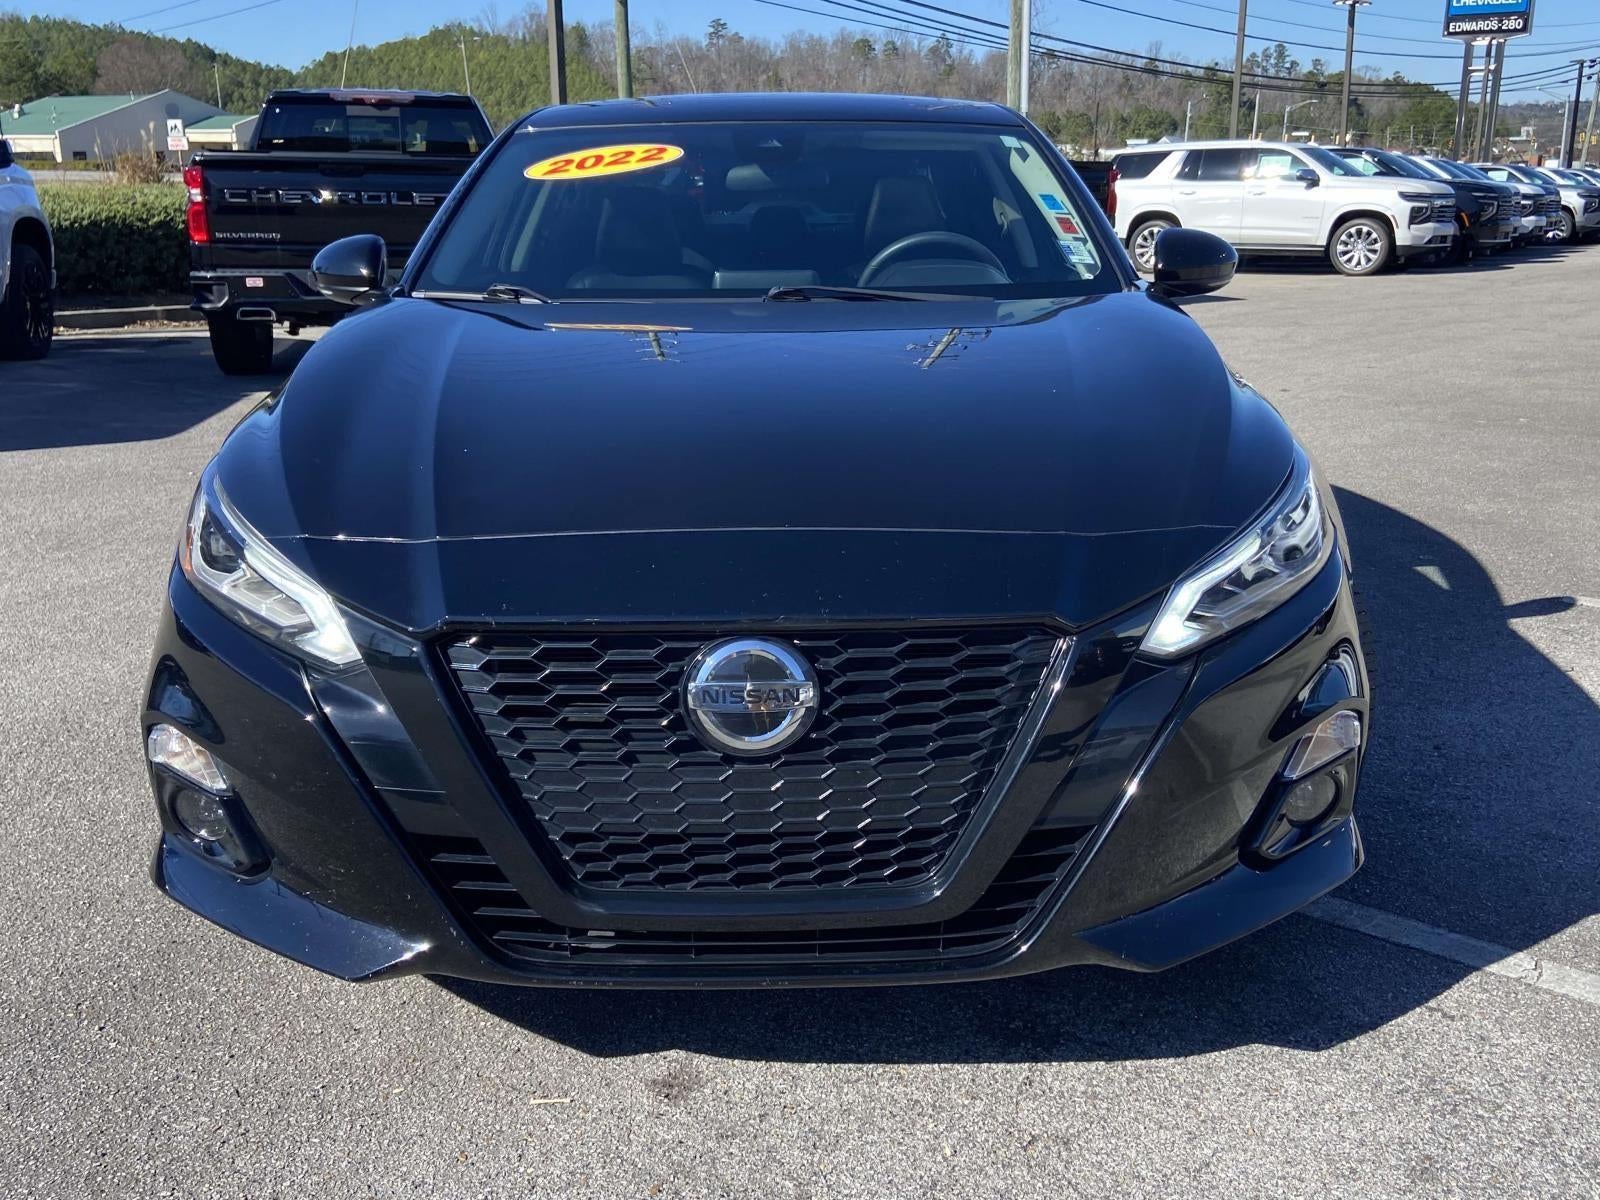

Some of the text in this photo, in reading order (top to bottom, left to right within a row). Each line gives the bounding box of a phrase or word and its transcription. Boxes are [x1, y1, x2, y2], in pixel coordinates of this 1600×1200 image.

[1449, 18, 1523, 32] EDWARDS-280
[541, 147, 668, 176] 2022
[702, 688, 800, 704] NISSAN
